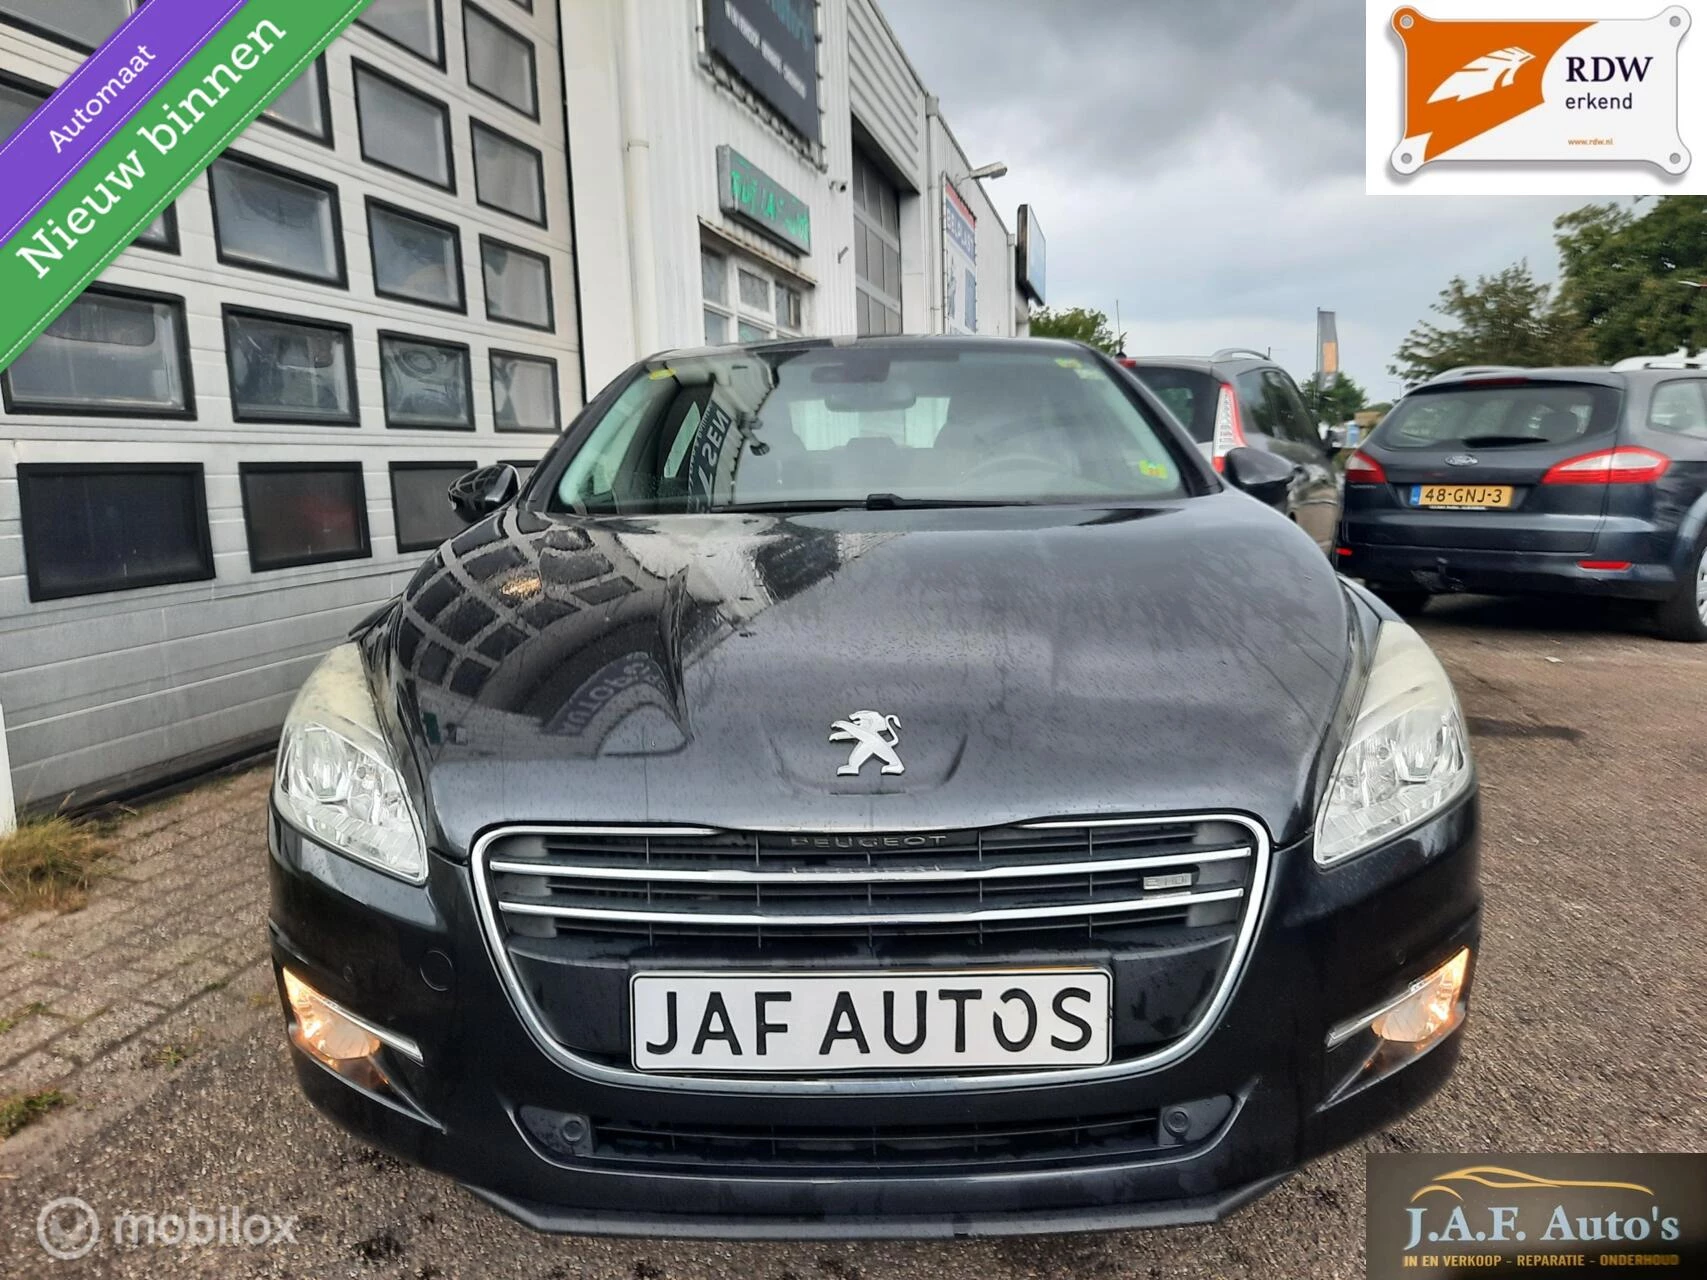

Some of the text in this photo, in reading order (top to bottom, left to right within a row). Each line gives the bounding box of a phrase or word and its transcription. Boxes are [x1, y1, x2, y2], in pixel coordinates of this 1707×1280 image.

[1425, 488, 1502, 503] 48-GNJ-3
[791, 835, 947, 848] PEUGEOT
[645, 987, 1093, 1056] JAF AUTOS
